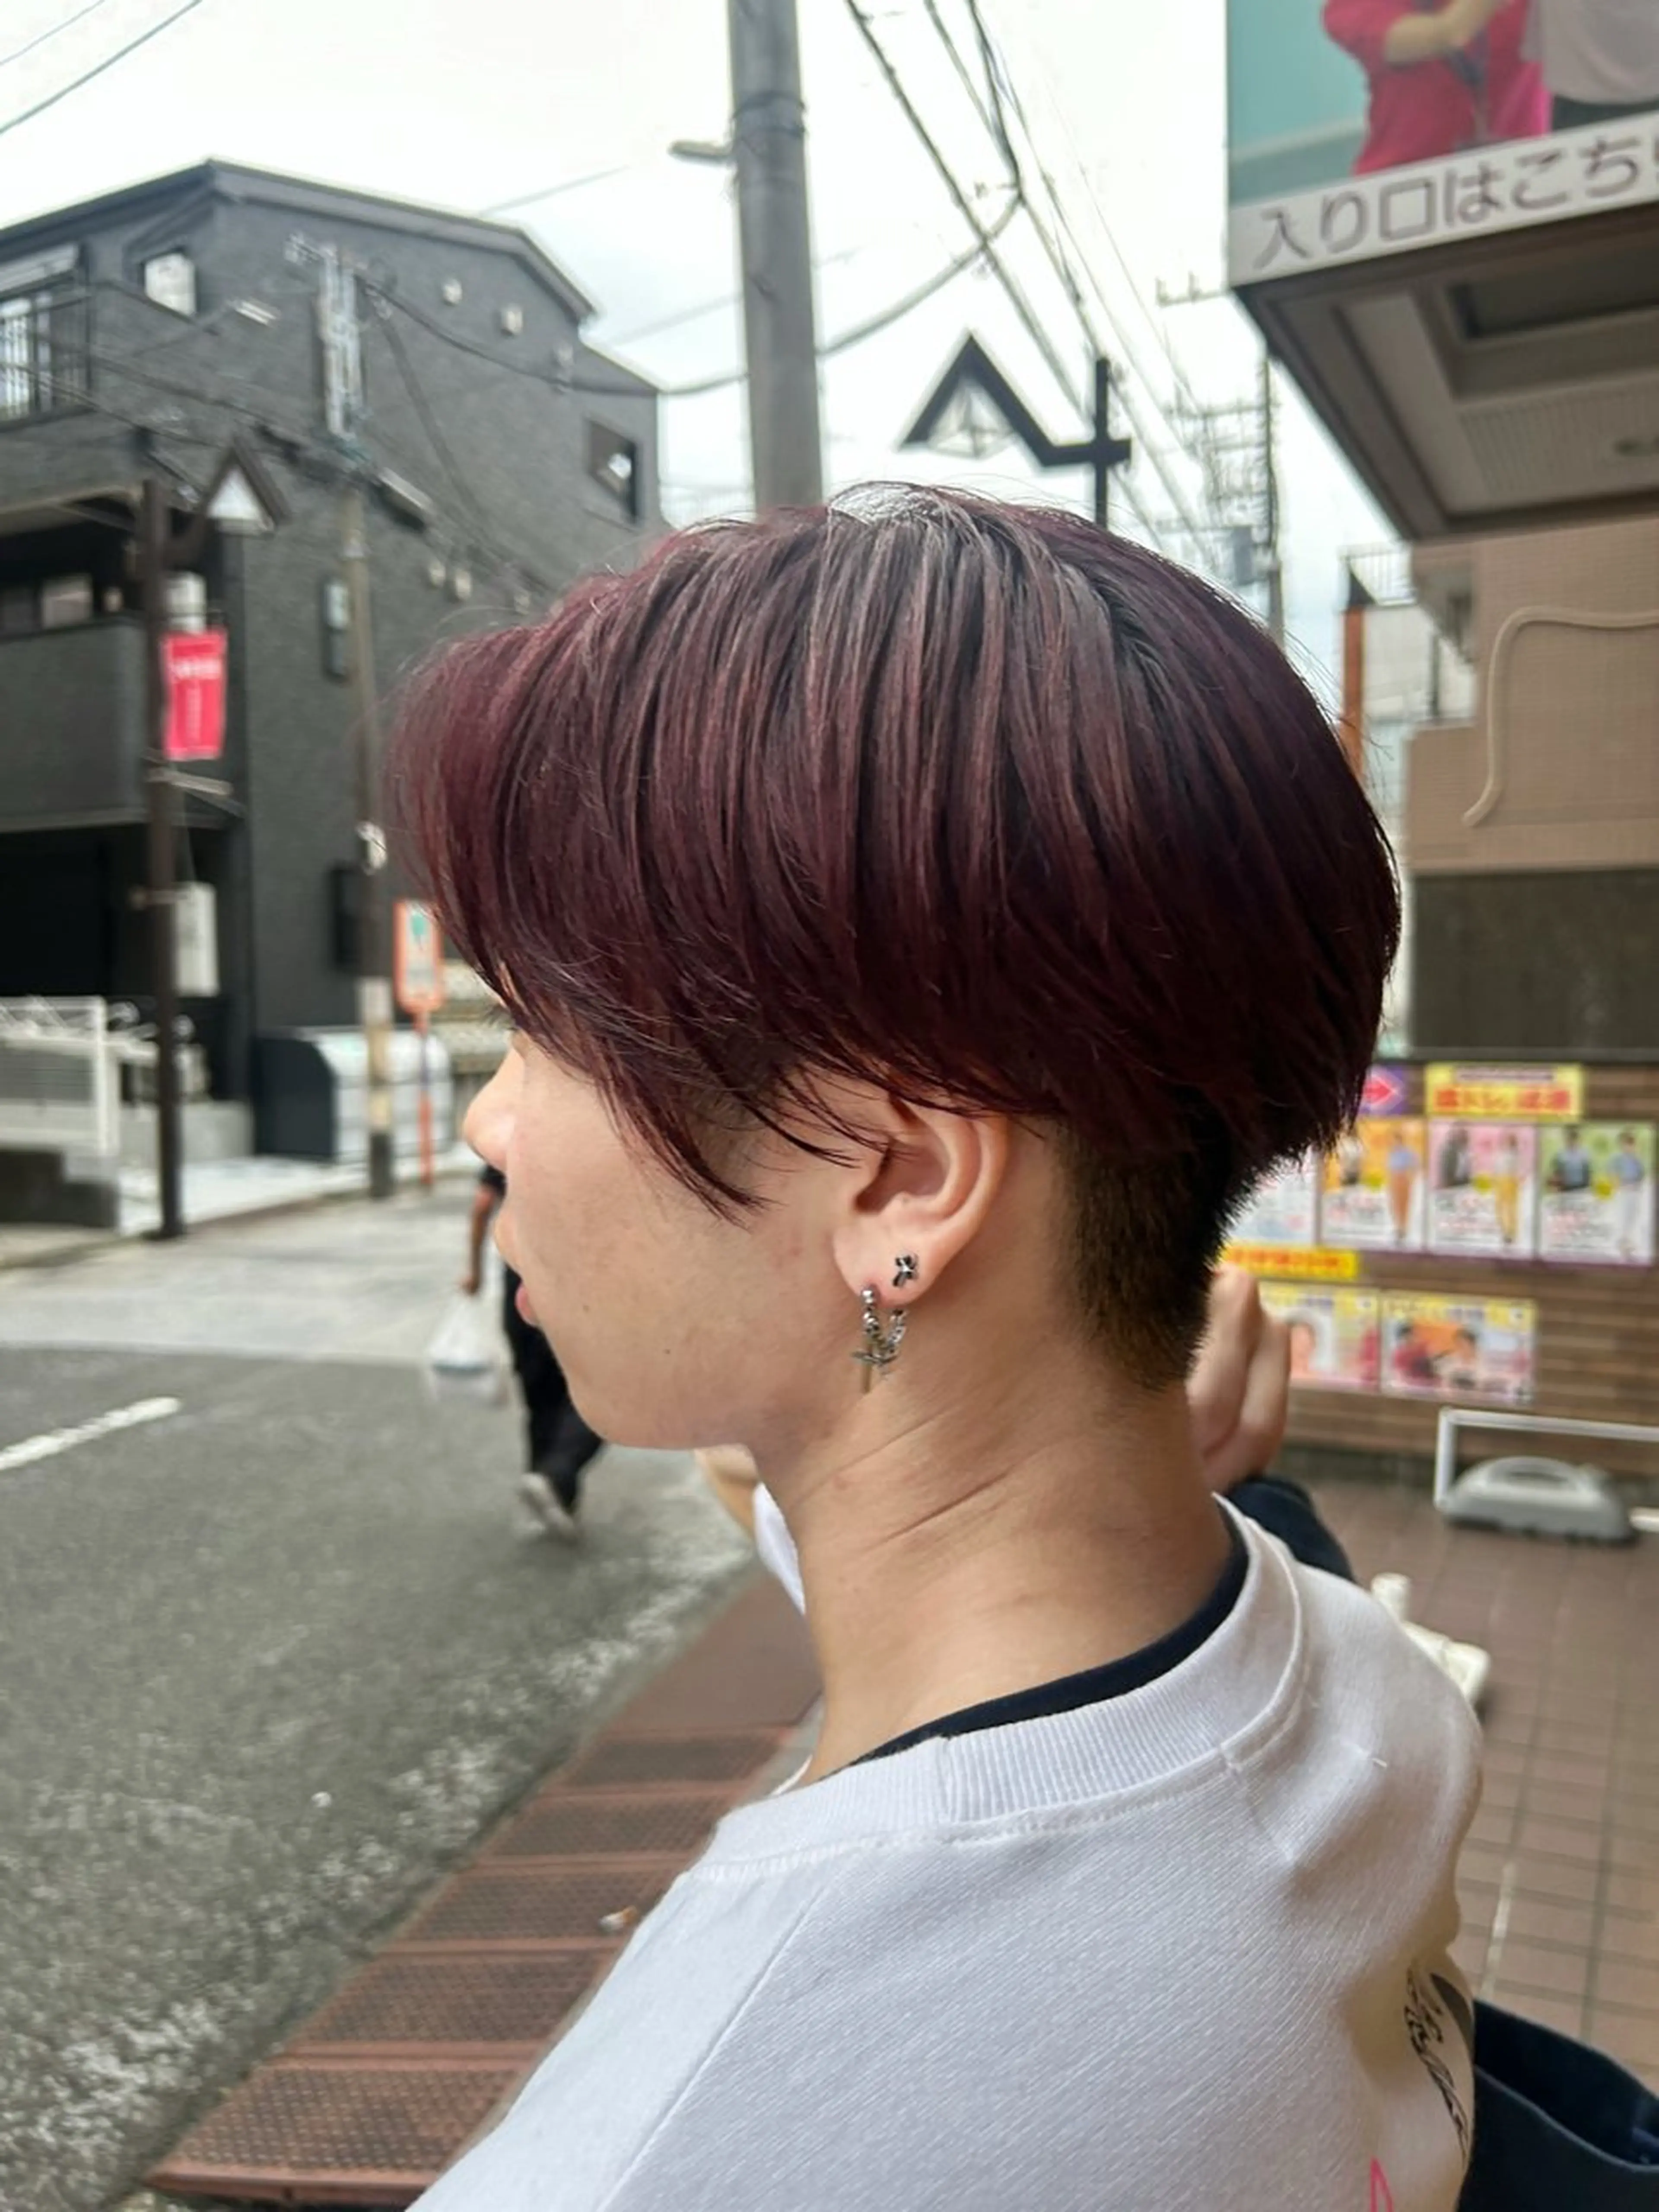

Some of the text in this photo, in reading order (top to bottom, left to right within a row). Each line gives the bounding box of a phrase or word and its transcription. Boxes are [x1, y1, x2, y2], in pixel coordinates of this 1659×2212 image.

[1253, 135, 1659, 270] 入り口はこち
